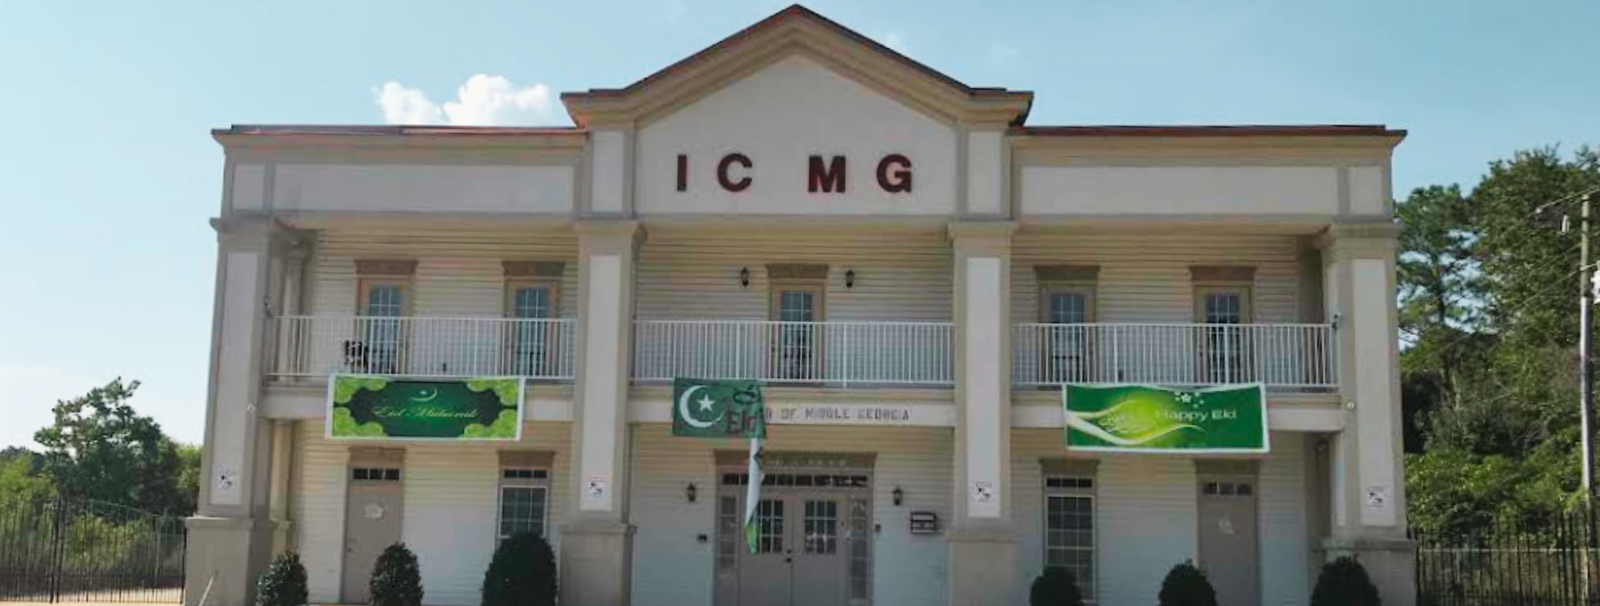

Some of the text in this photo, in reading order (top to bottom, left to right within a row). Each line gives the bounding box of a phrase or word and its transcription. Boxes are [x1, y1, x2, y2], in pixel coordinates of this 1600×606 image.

[781, 407, 796, 420] OF
[805, 407, 850, 420] MIDDLE
[857, 408, 910, 421] GEORGIA
[1155, 409, 1208, 422] Happy
